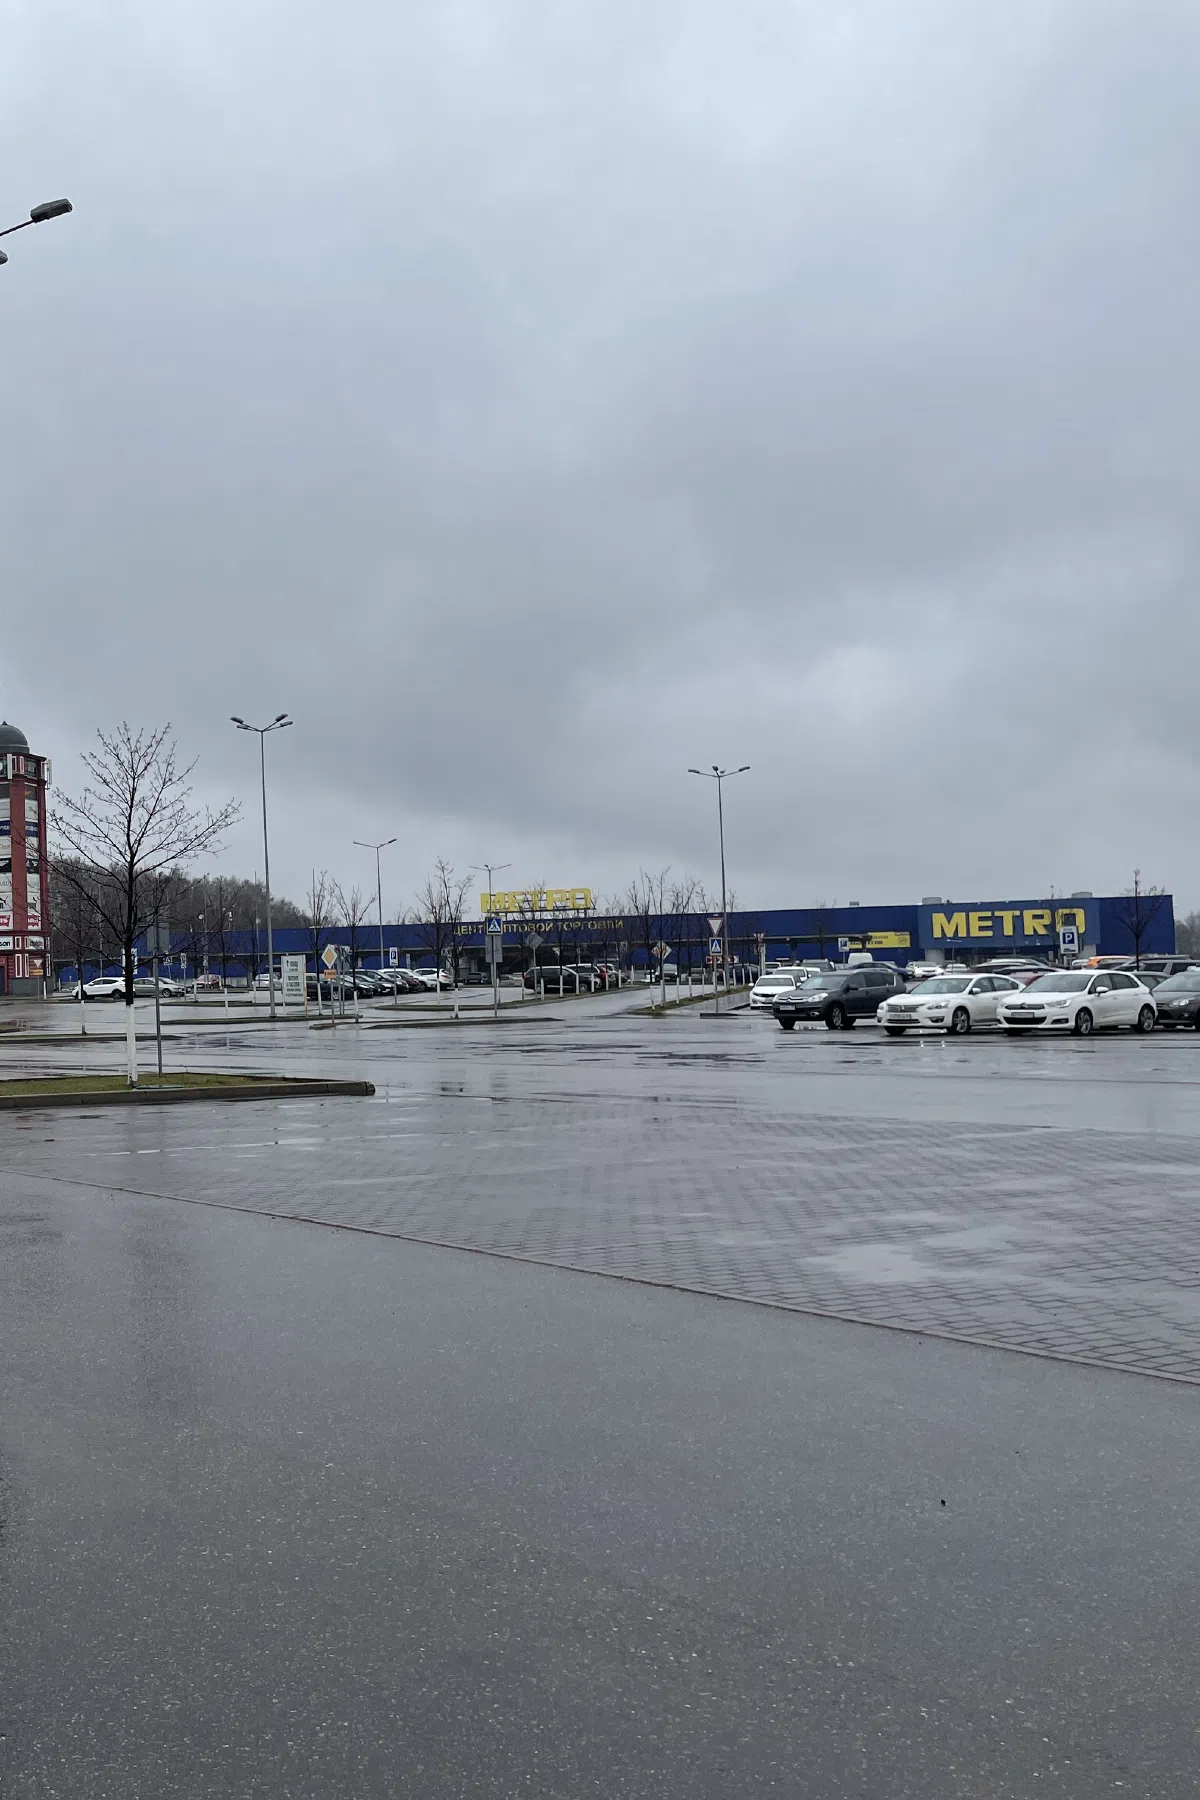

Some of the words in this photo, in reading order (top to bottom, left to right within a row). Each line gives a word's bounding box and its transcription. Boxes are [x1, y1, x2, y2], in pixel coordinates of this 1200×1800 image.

[454, 923, 488, 937] ЦЕНТ
[501, 921, 554, 934] ПТОВОЙ
[932, 908, 1086, 938] METRO
